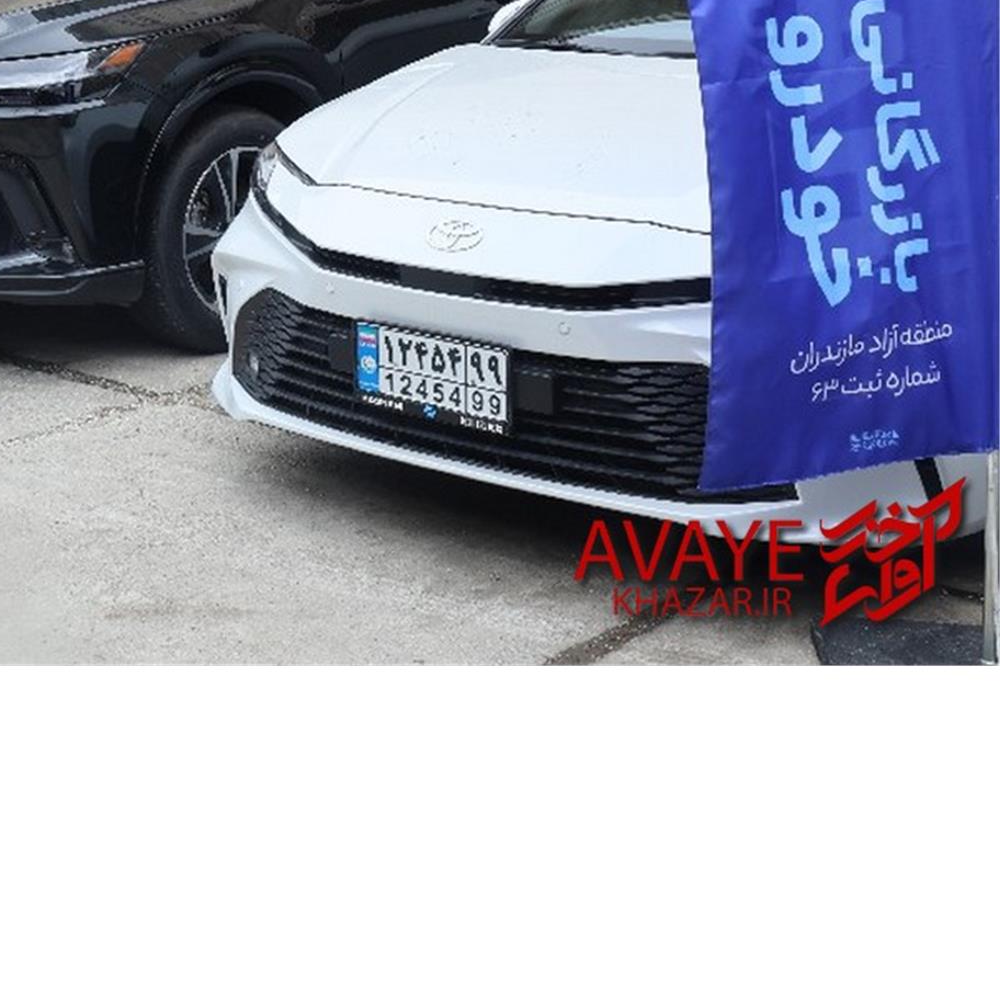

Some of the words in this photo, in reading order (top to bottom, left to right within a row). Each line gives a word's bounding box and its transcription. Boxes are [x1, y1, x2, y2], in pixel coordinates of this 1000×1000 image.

[766, 15, 874, 307] خودرو
[868, 323, 900, 359] آزاد
[899, 320, 953, 346] منطقه
[384, 335, 462, 377] ۱۲۴۵۴
[470, 351, 503, 386] ۹۹
[790, 334, 865, 375] مازندران
[384, 373, 462, 407] 12454
[470, 390, 502, 416] 99
[841, 369, 883, 399] ثبت
[886, 361, 942, 397] شماره
